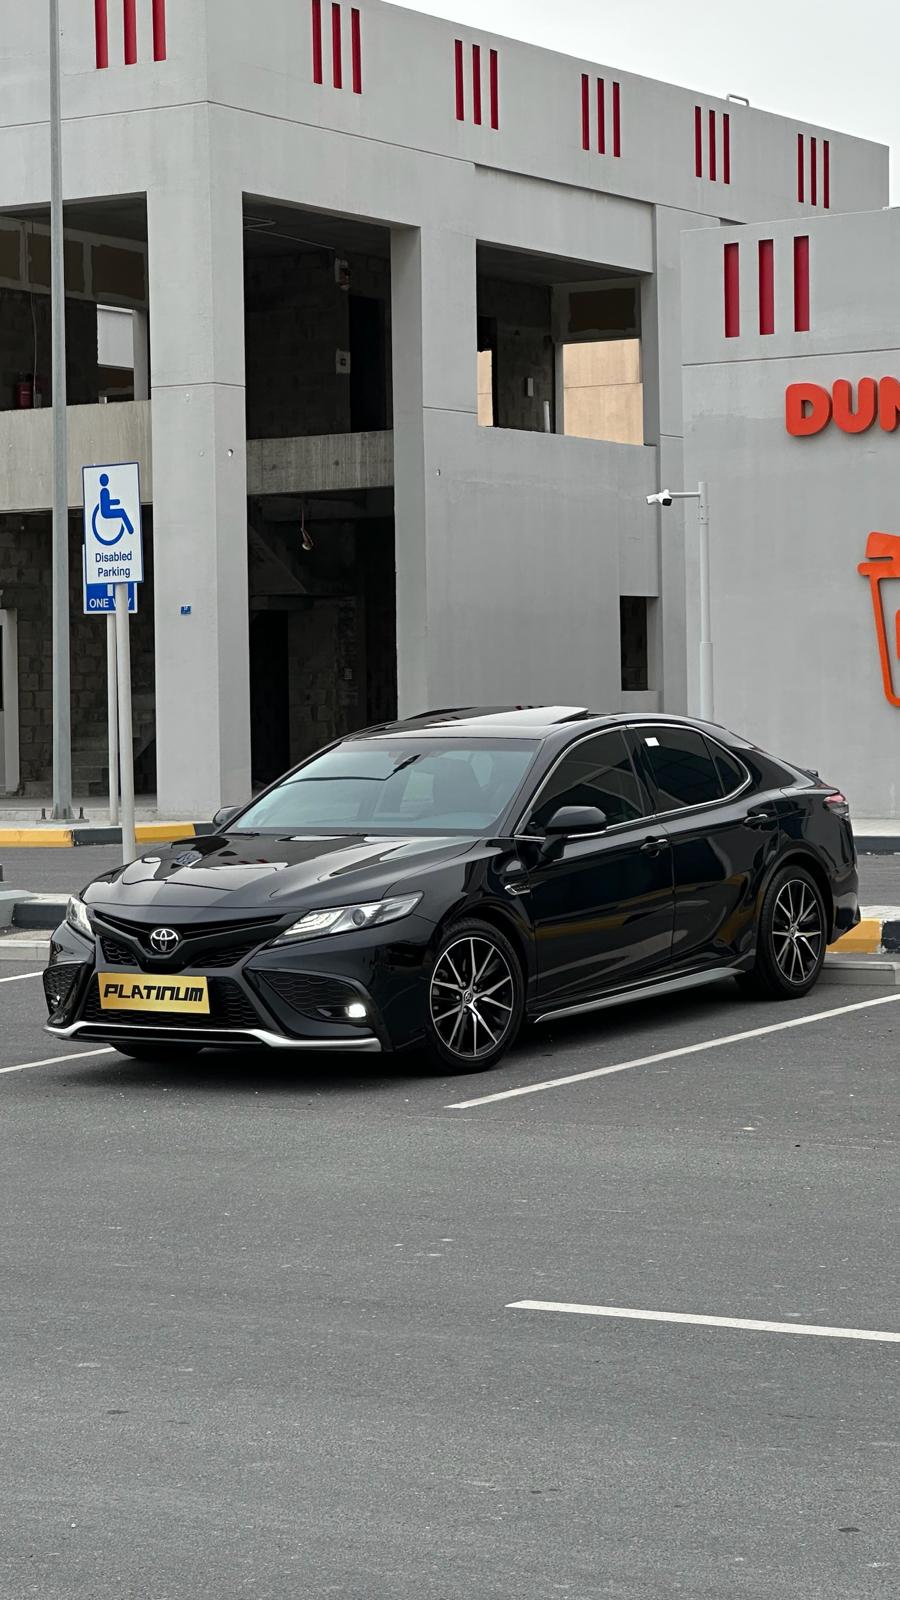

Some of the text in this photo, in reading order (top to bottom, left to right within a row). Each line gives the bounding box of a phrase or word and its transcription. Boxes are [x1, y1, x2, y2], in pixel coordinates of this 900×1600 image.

[95, 551, 132, 562] Disabled
[97, 567, 131, 578] Parking
[89, 598, 109, 608] ONE
[104, 984, 204, 1002] PLATINUM
